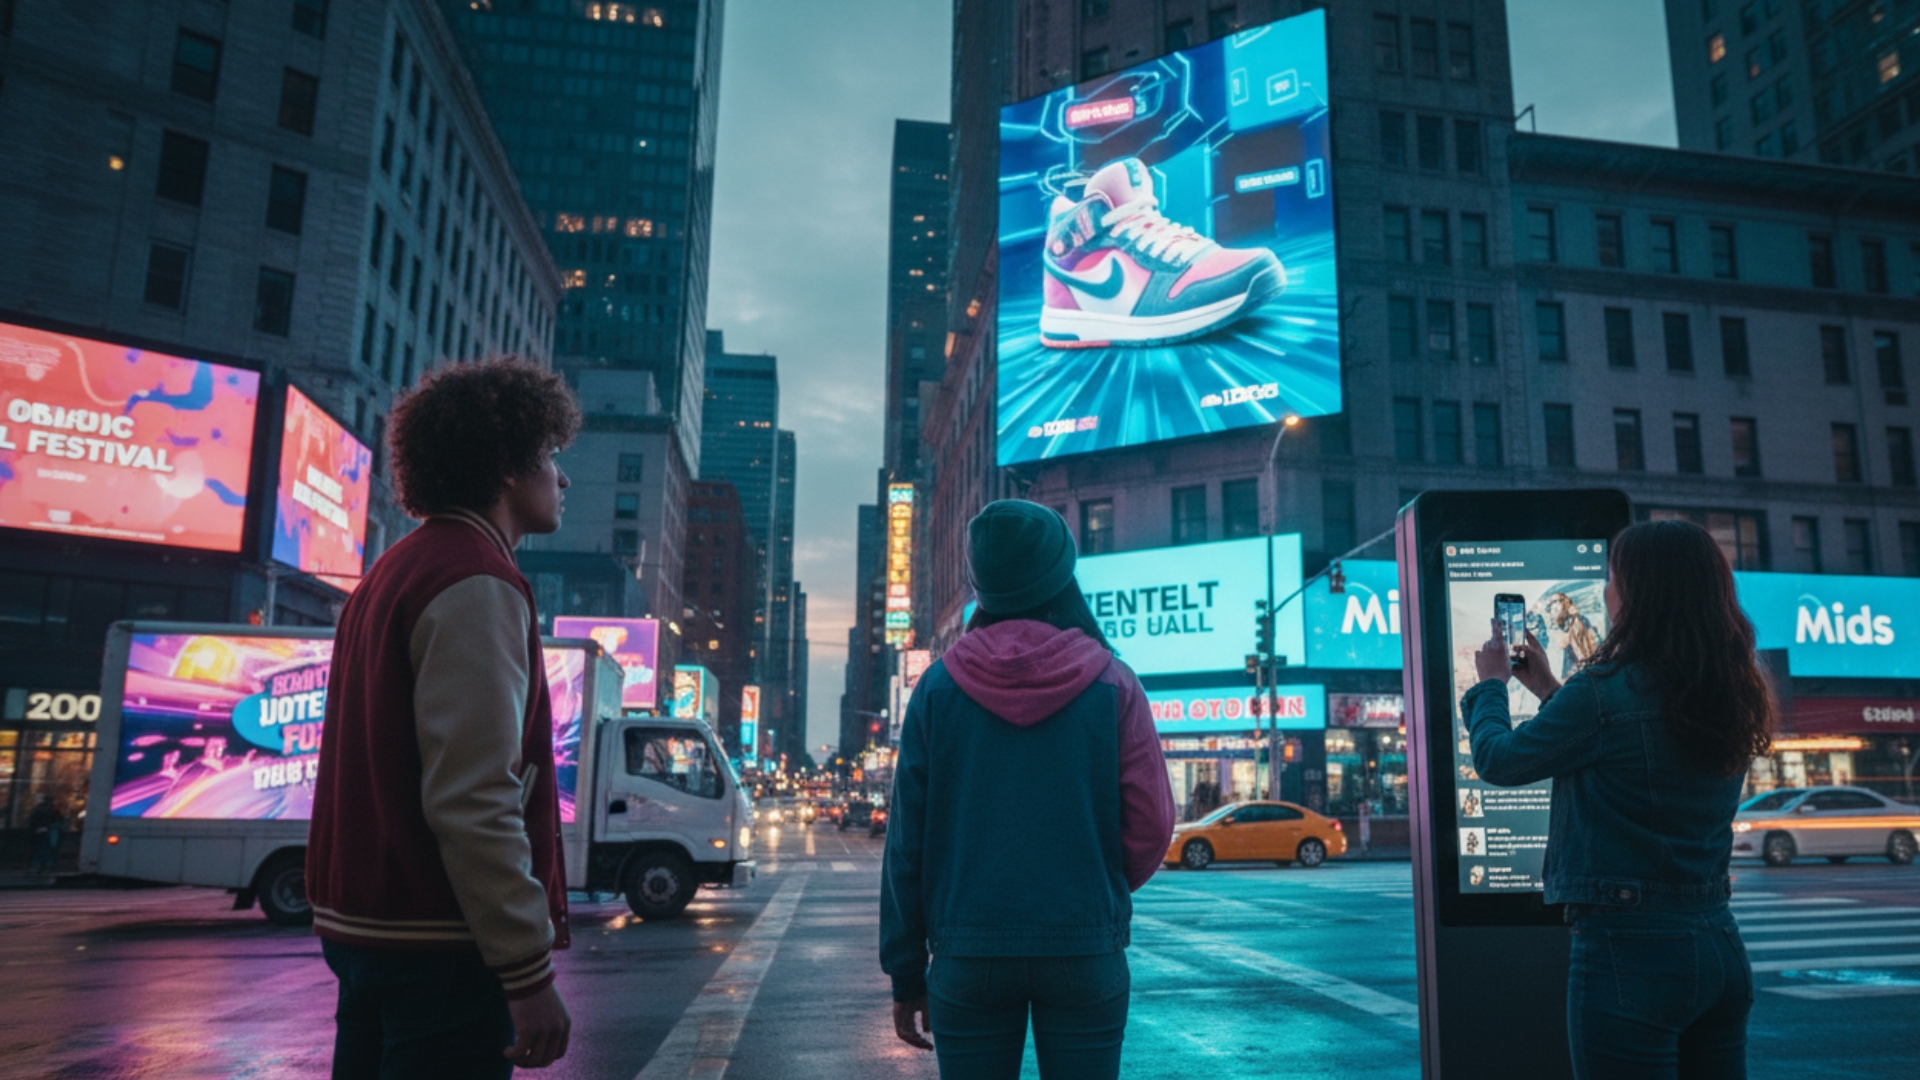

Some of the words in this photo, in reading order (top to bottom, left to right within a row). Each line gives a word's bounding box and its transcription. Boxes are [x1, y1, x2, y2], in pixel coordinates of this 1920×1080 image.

[27, 430, 174, 472] FESTIVAL
[1796, 602, 1895, 645] Mids
[26, 693, 102, 721] 200
